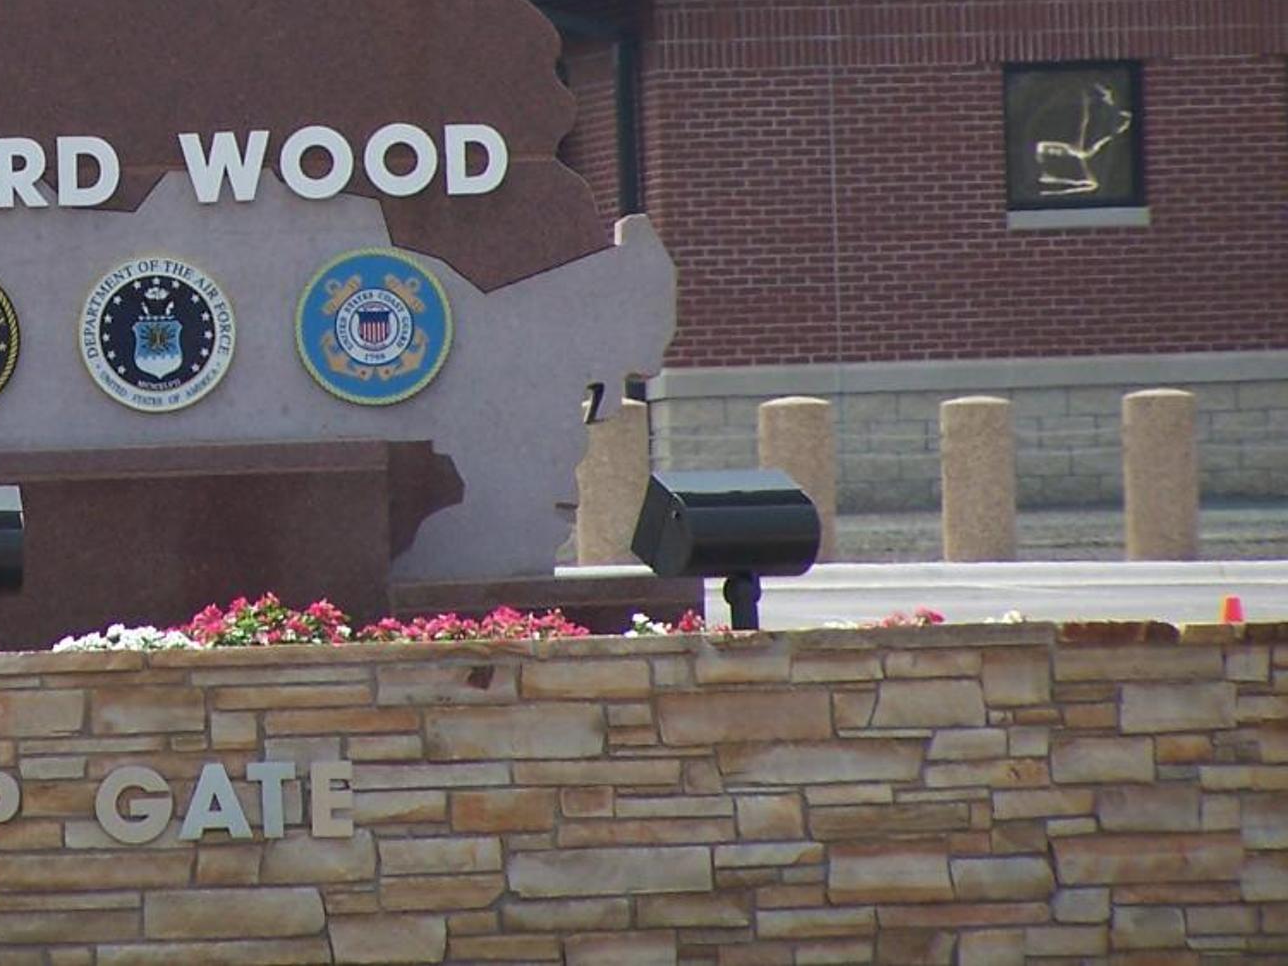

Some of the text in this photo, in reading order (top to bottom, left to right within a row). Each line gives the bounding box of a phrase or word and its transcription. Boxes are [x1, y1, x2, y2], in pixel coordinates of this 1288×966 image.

[178, 123, 509, 204] WOOD
[84, 259, 232, 360] DEPARTMENT OF THE AIR FORCE
[94, 760, 356, 846] GATE
